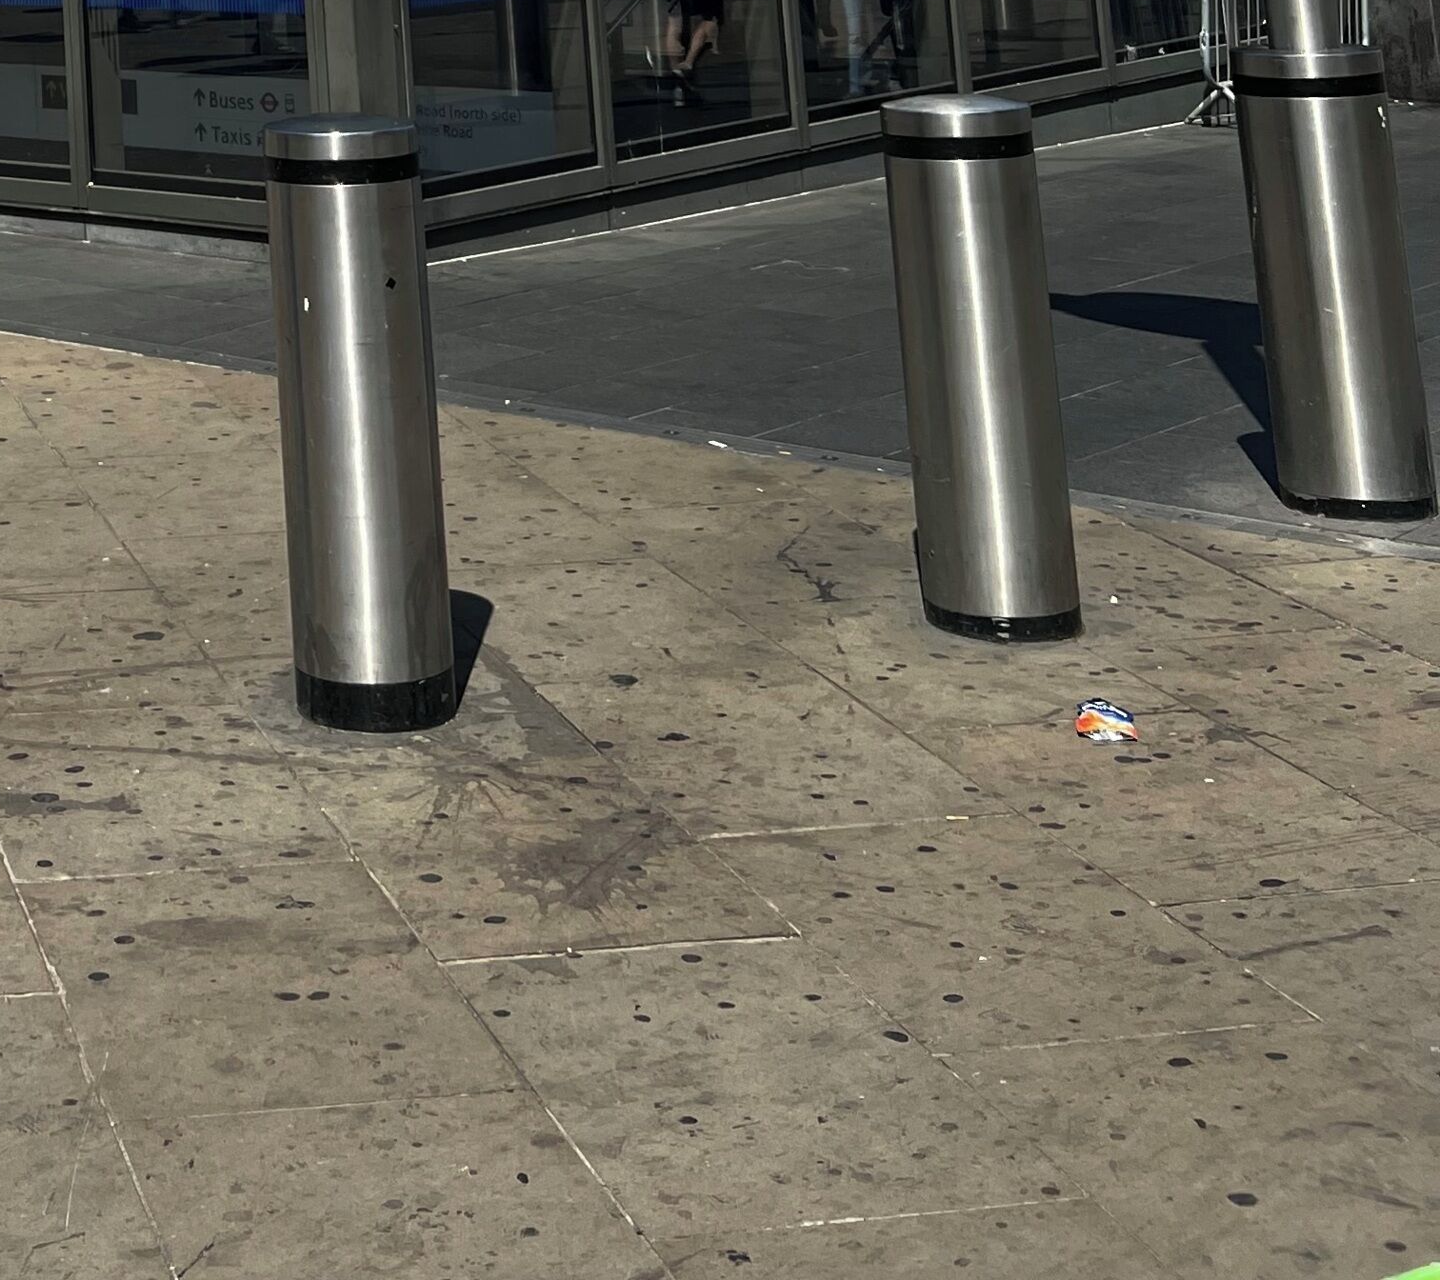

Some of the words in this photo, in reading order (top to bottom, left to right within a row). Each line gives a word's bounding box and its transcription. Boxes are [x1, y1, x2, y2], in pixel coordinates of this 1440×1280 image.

[209, 90, 255, 111] Buses
[211, 125, 253, 147] Taxis
[443, 124, 473, 140] Road
